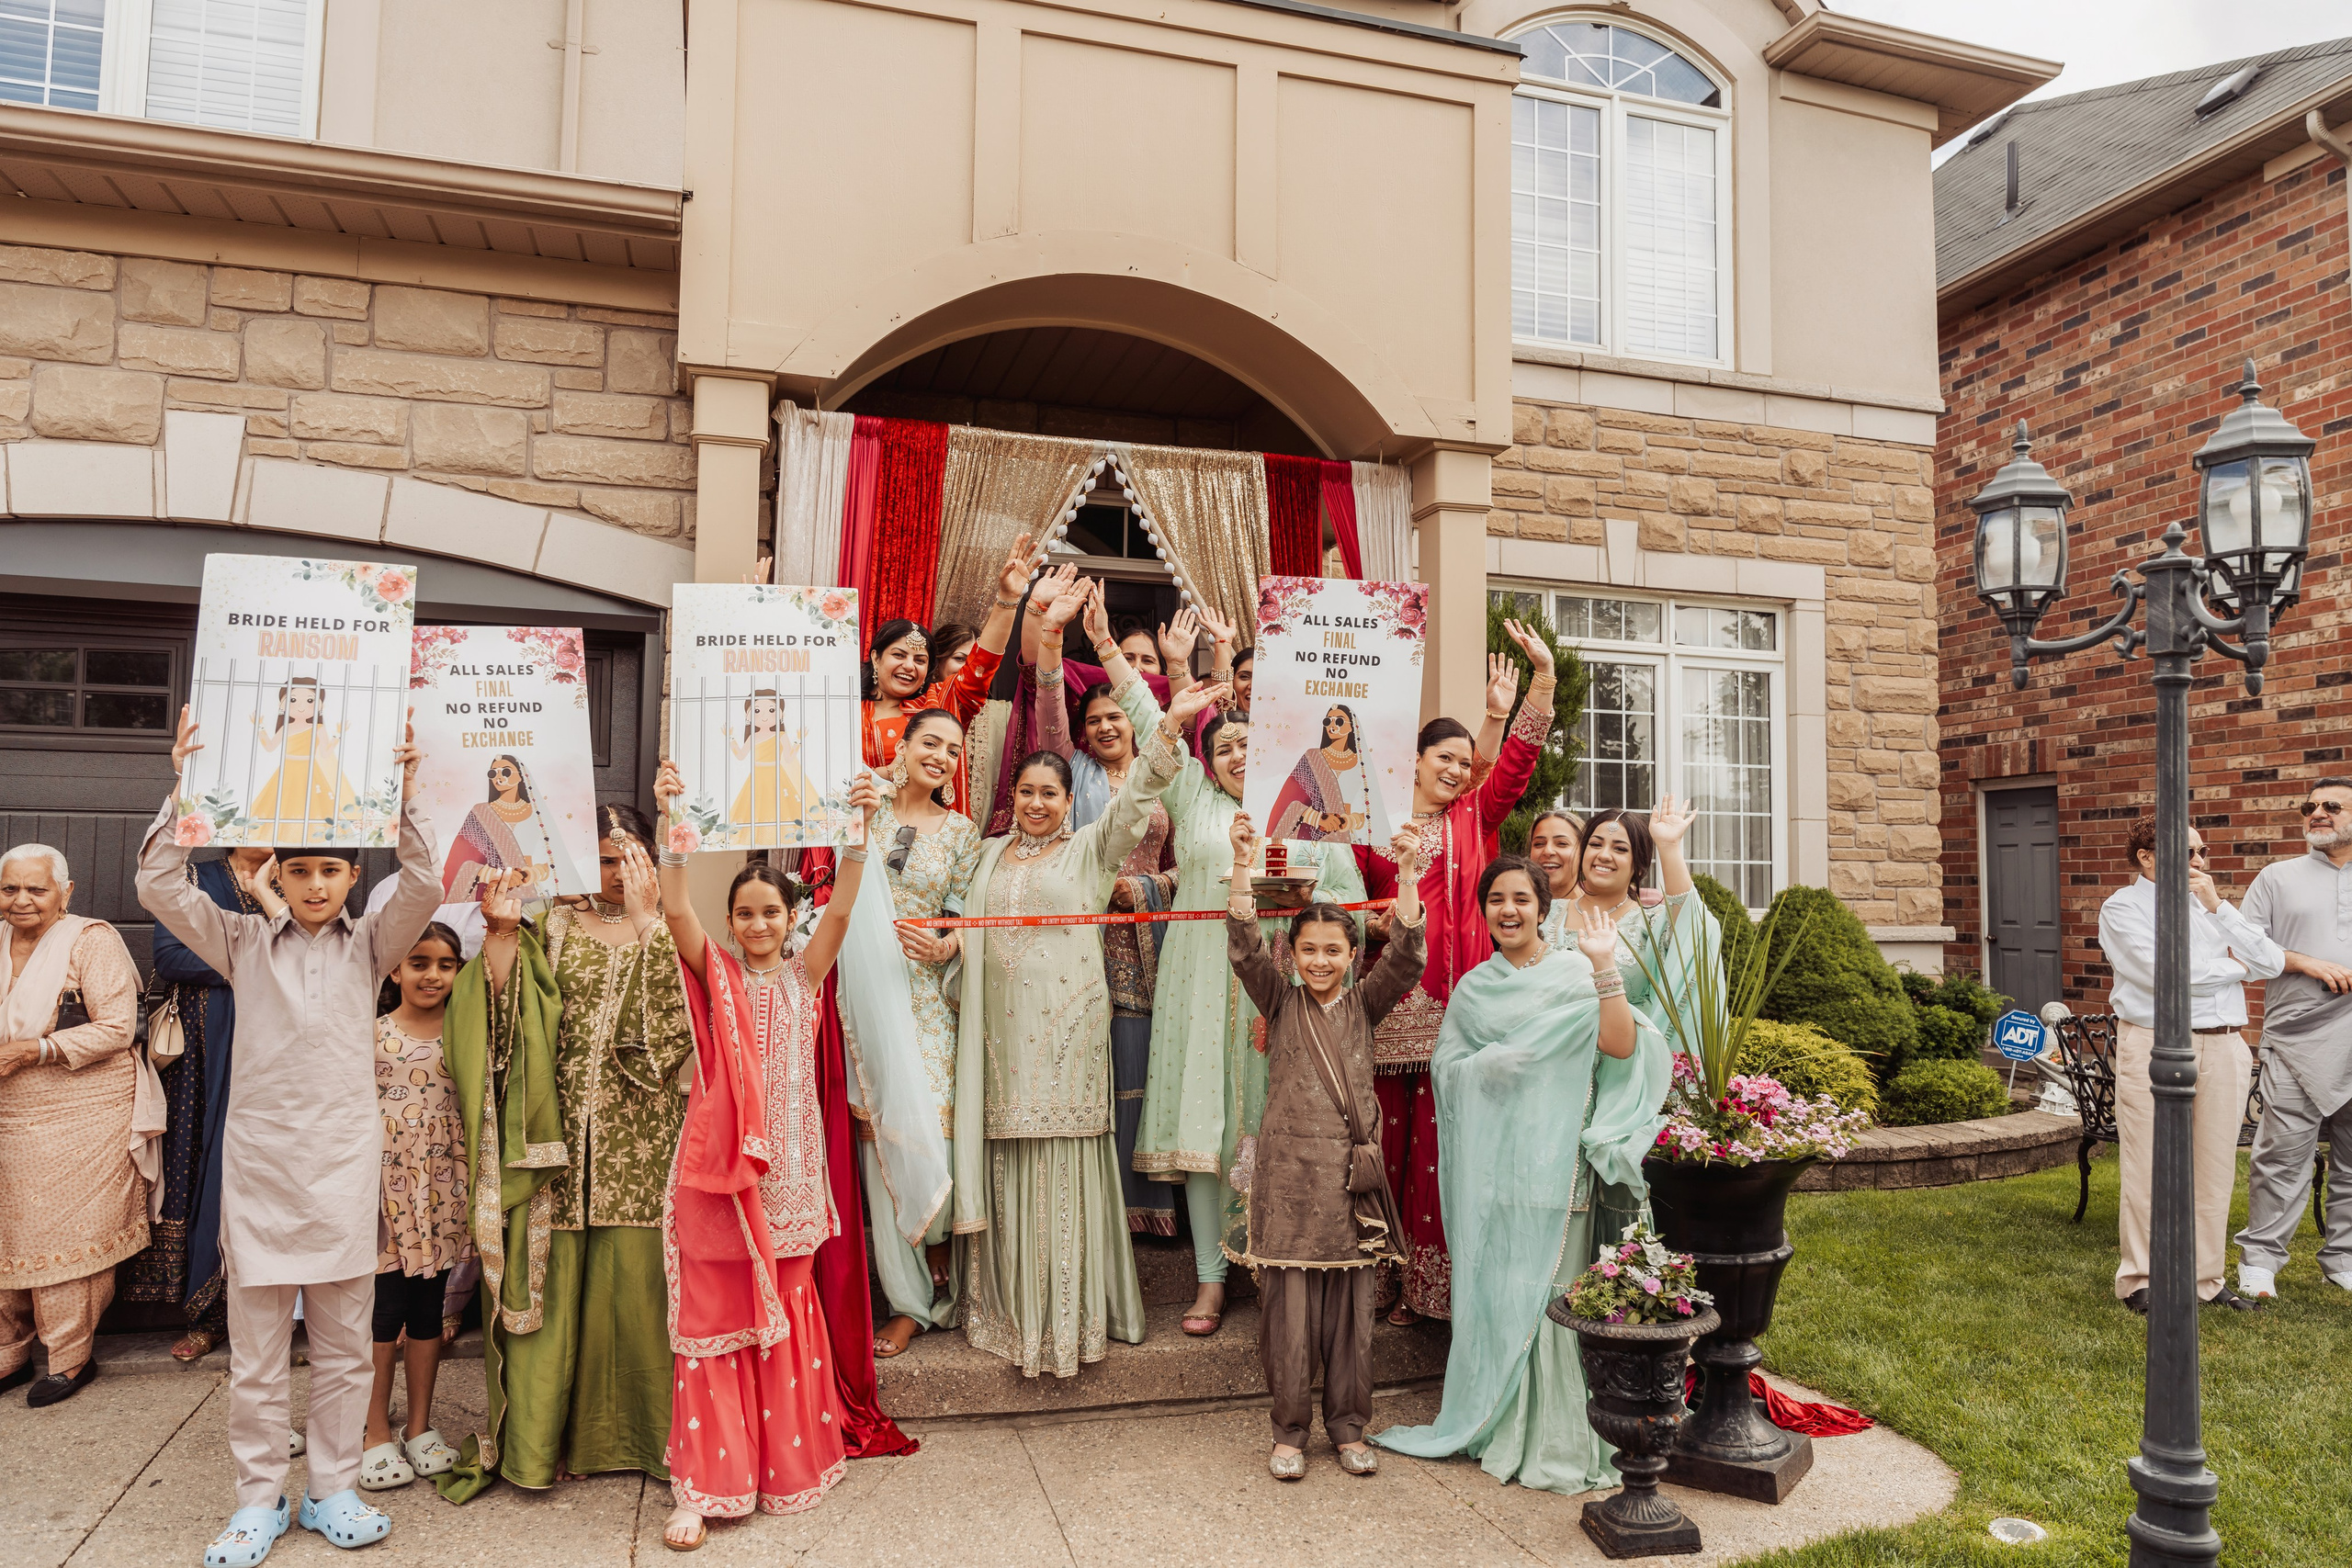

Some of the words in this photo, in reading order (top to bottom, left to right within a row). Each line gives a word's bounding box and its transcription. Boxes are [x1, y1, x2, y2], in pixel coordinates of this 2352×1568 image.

[228, 613, 288, 627] BRIDE
[295, 616, 345, 631] HELD
[353, 619, 390, 633] FOR
[1303, 615, 1329, 626] ALL
[1334, 616, 1378, 629] SALES
[257, 630, 359, 661] RANSOM
[695, 635, 747, 647] BRIDE
[753, 635, 797, 646] HELD
[804, 636, 837, 647] FOR
[1323, 631, 1357, 649] FINAL
[723, 649, 810, 673] RANSOM
[1295, 651, 1317, 663] NO
[1322, 653, 1381, 667] REFUND
[449, 664, 481, 676] ALL
[486, 664, 535, 676] SALES
[1325, 668, 1348, 679] NO
[476, 680, 514, 697] FINAL
[1305, 680, 1369, 699] EXCHANGE
[446, 703, 471, 715] NO
[478, 702, 543, 714] REFUND
[483, 717, 508, 728] NO
[462, 730, 534, 749] EXCHANGE
[2003, 1026, 2038, 1046] ADT
